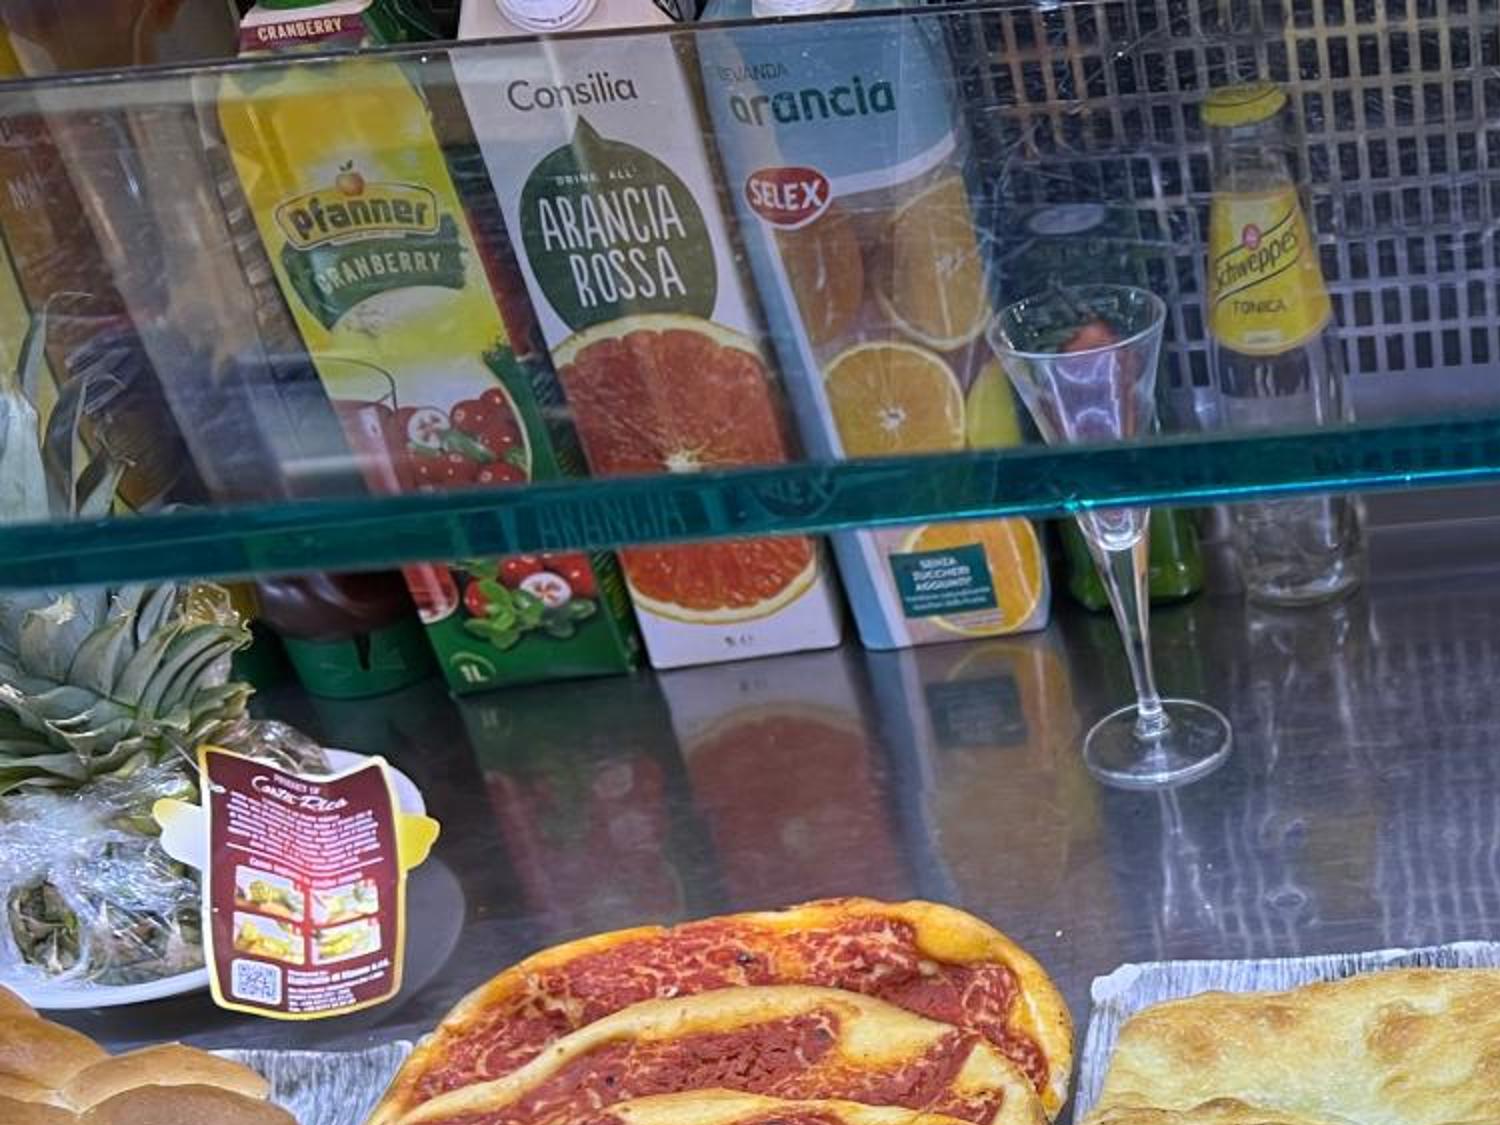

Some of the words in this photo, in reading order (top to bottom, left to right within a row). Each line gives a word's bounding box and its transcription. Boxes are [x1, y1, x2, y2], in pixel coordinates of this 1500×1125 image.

[256, 17, 342, 42] CRANBERRY
[507, 71, 638, 112] Consilia
[729, 75, 897, 126] arancia
[750, 178, 824, 211] SELEX
[289, 198, 429, 241] pfanner
[539, 184, 687, 251] ARANCIA
[313, 251, 442, 295] CRANBERRY
[569, 245, 687, 307] ROSSA
[460, 664, 489, 683] 1L
